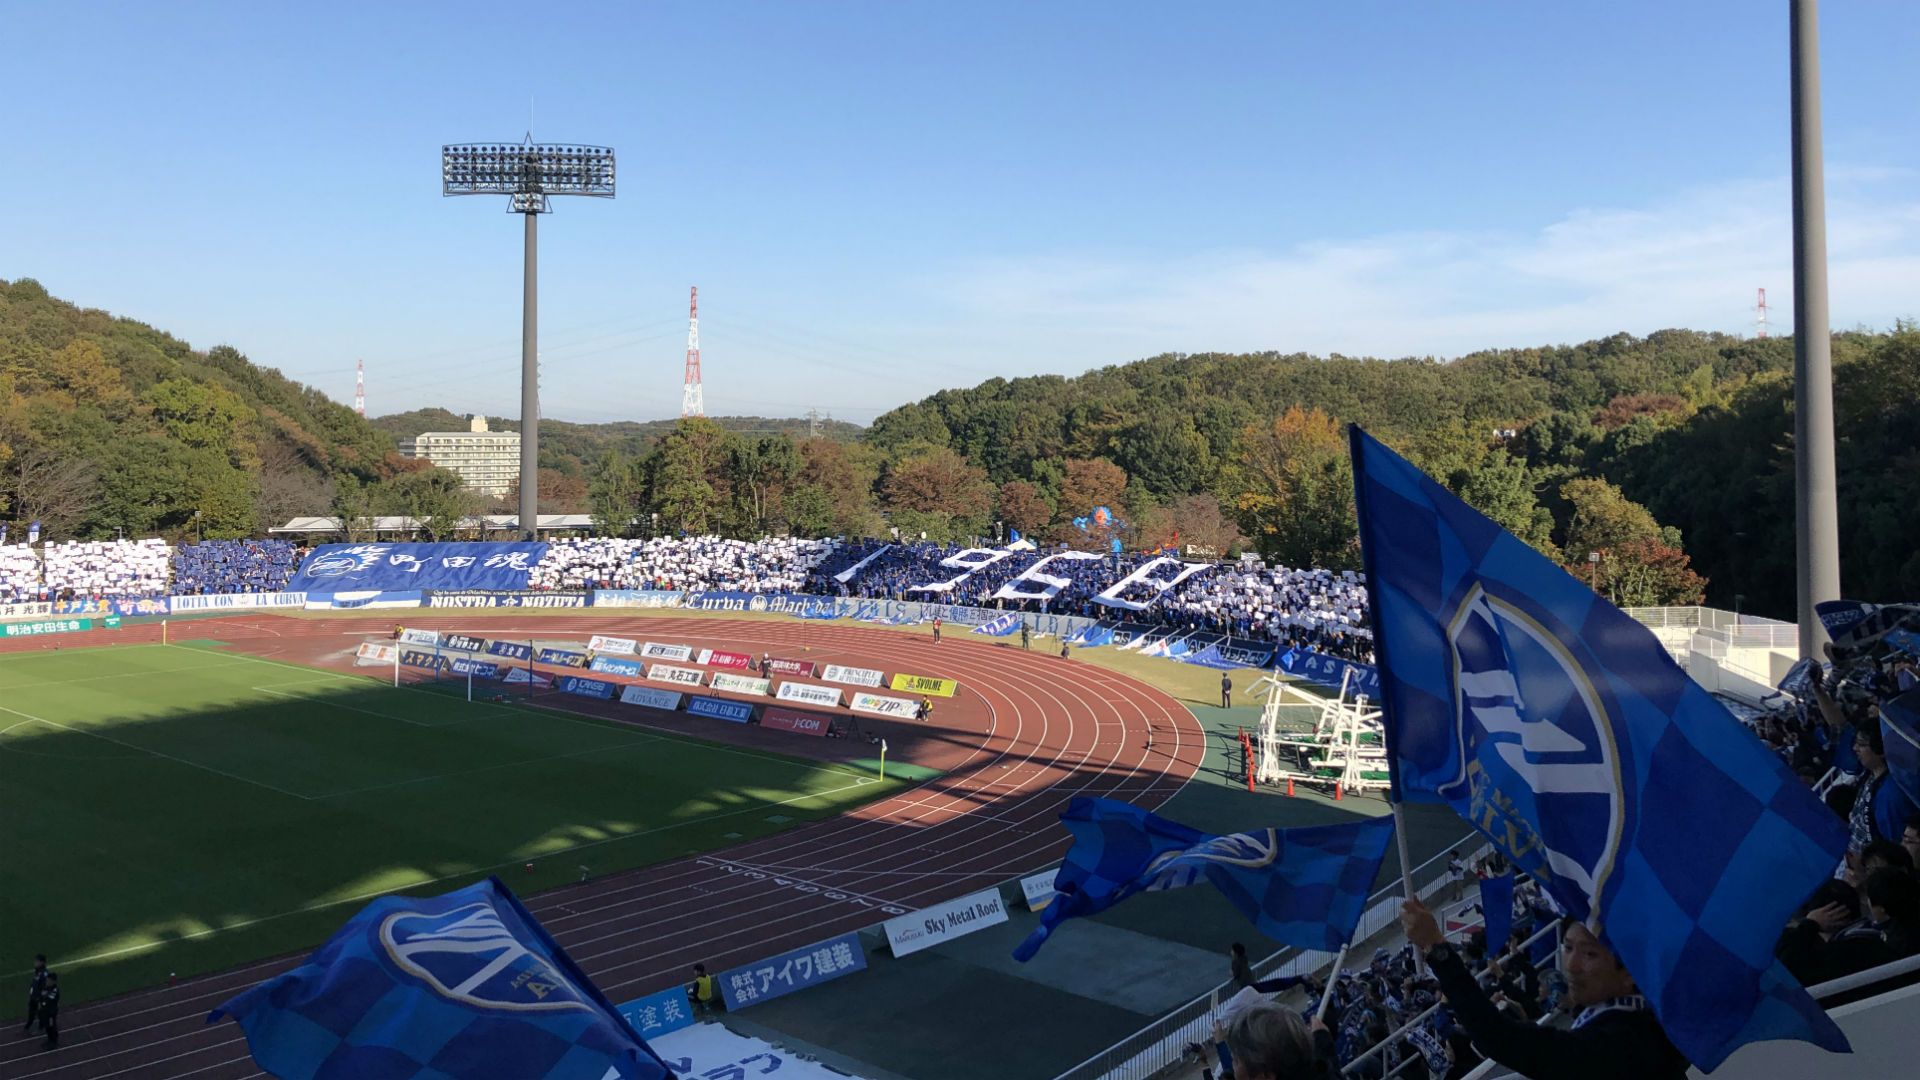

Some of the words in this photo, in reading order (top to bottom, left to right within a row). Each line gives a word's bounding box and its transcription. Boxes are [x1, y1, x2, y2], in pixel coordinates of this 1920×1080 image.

[177, 594, 208, 609] LOTTA
[214, 594, 234, 607] CON
[256, 593, 268, 606] LA
[274, 592, 304, 605] CURVA
[429, 596, 497, 608] NOSTRA
[6, 620, 80, 636] 明治安田生命
[668, 670, 700, 684] 丸石工業
[916, 677, 943, 691] SVOLME
[629, 692, 671, 706] ADVANCE
[877, 700, 900, 712] ZIP
[719, 865, 743, 873] 2
[743, 871, 767, 879] 3
[773, 877, 793, 886] 4
[794, 884, 819, 893] 5
[823, 891, 847, 900] 6
[850, 898, 874, 907] 7
[881, 905, 906, 915] 8
[924, 918, 945, 935] Sky
[946, 906, 977, 928] Metal
[975, 898, 1000, 918] Roof
[756, 941, 855, 994] アイワ建装
[731, 970, 754, 990] 株式
[735, 984, 759, 1004] 会社
